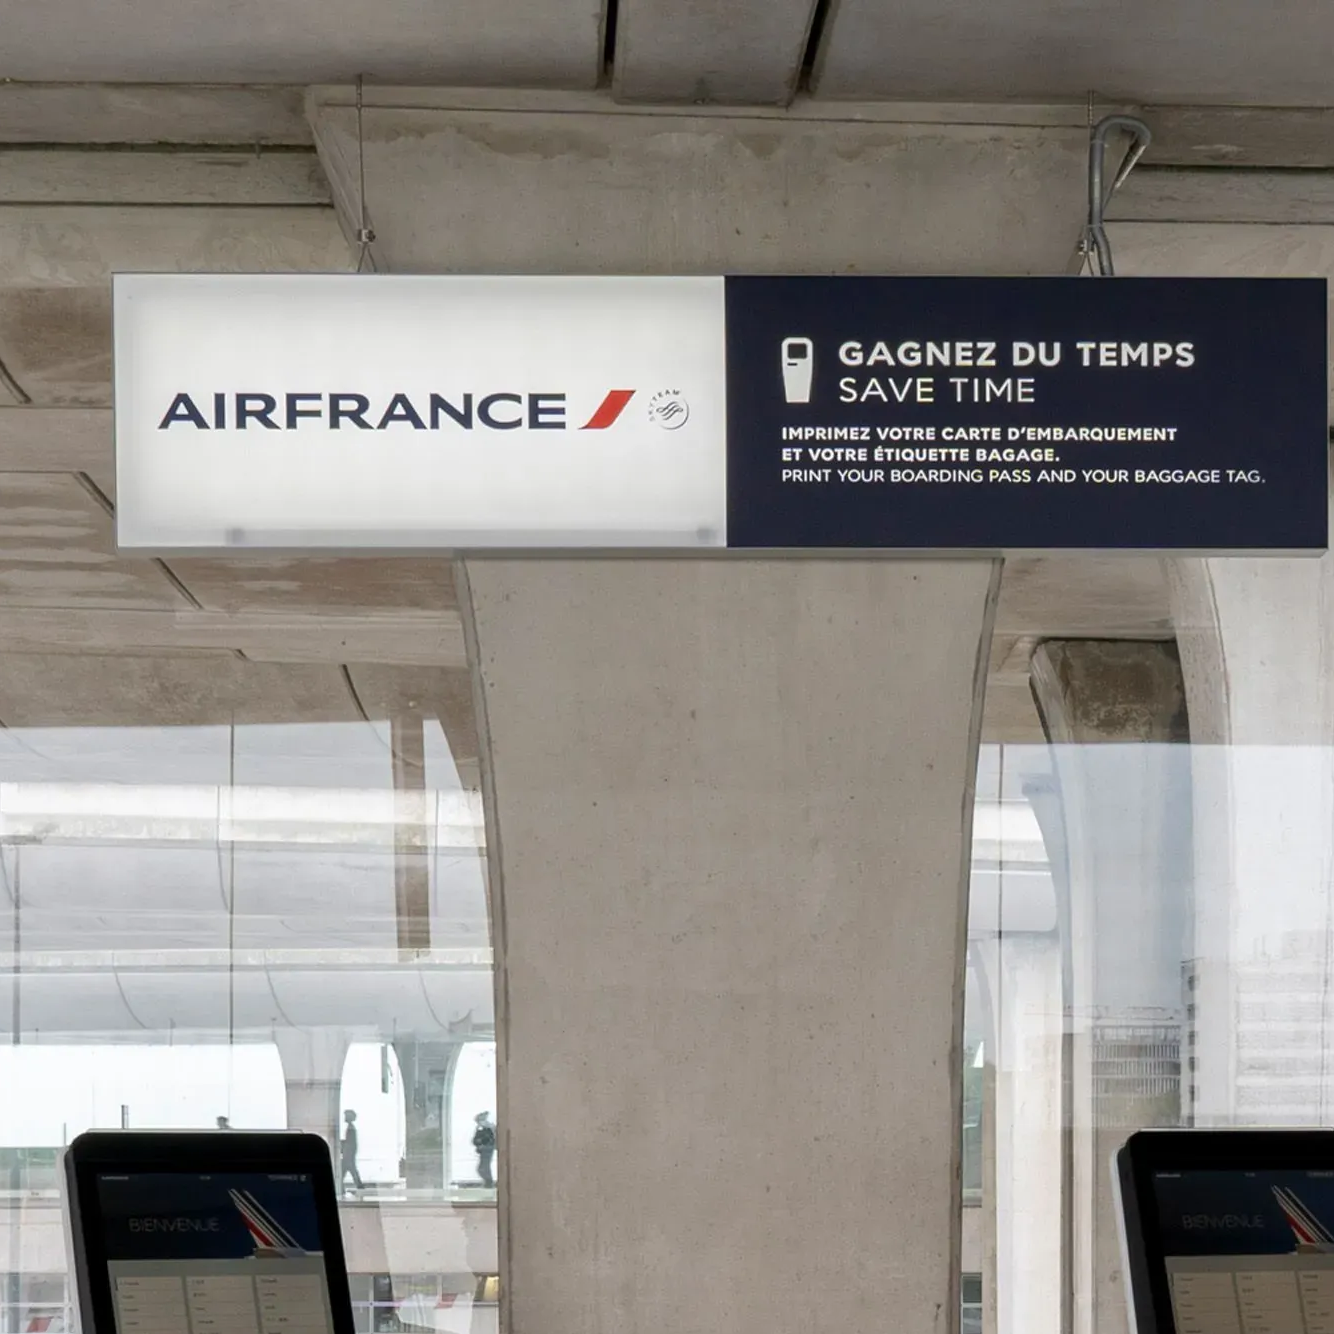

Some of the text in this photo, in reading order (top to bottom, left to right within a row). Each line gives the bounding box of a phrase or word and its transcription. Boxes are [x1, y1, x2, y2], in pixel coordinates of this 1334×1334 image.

[838, 341, 1196, 367] GAGNEZ DU TEMPS
[839, 377, 1035, 403] SAVE TIME
[158, 392, 567, 430] AIRFRANCE
[781, 426, 871, 441] IMPRIMEZ
[875, 426, 936, 441] VOTRE
[941, 426, 1002, 441] CARTE
[781, 444, 1060, 463] ET VOTRE ÉTIQUETTE BAGAGE.
[781, 468, 1266, 484] PRINT YOUR BOARDING PASS AND YOUR BAGGAGE TAG.
[128, 1216, 221, 1232] BIENVENUE
[1181, 1214, 1265, 1229] BIENVENUE
